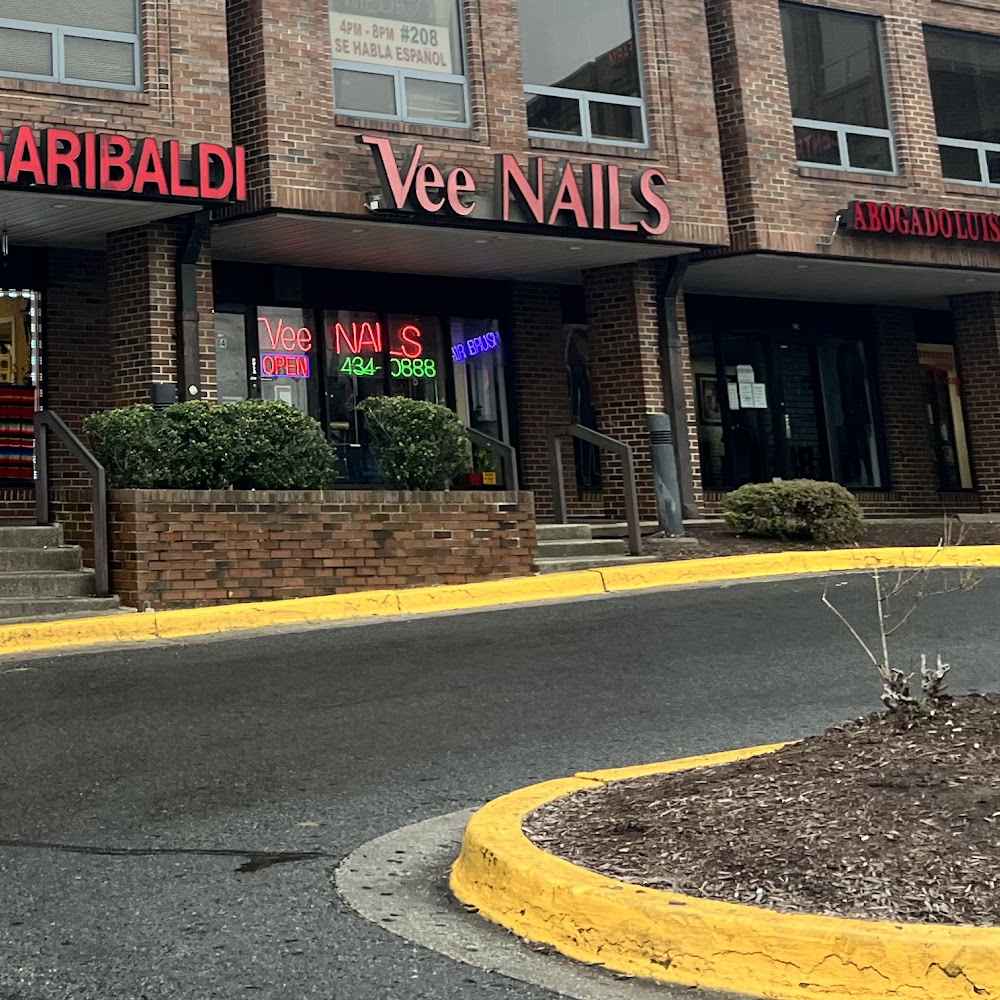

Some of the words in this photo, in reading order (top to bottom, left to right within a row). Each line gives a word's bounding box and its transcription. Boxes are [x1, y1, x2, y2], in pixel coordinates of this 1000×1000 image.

[339, 20, 363, 36] 4PM
[372, 24, 394, 41] 8PM
[400, 24, 439, 47] #208
[335, 38, 350, 54] SE
[352, 40, 393, 60] HABLA
[360, 135, 477, 216] Vee
[500, 154, 671, 236] NAILS
[854, 200, 953, 239] ABOGADO
[262, 355, 309, 376] OPEN
